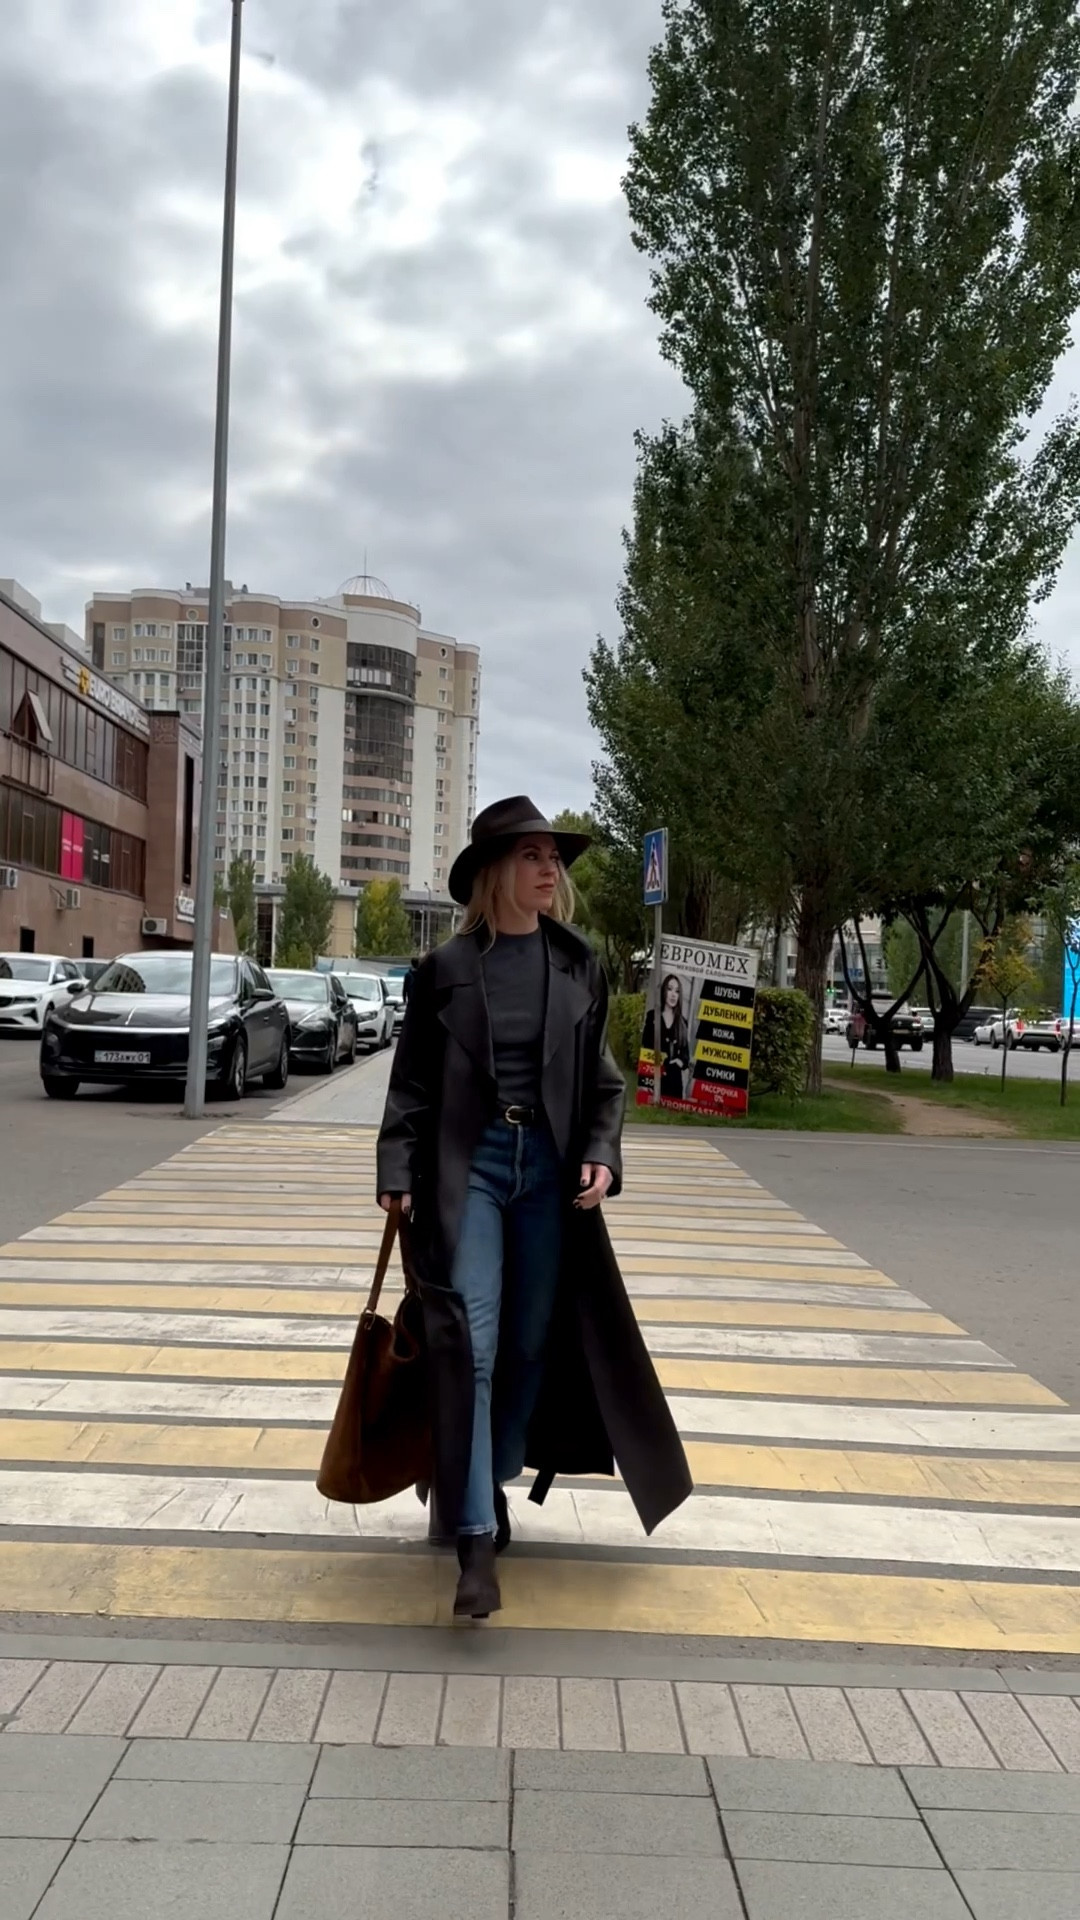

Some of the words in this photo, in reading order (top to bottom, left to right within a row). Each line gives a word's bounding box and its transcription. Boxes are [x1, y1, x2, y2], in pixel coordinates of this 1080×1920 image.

[660, 943, 748, 974] ЕВРОМЕХ
[714, 986, 741, 1000] ШУБЫ
[702, 1004, 747, 1022] ДУБЛЕНКИ
[712, 1027, 735, 1041] КОЖА
[701, 1045, 743, 1063] МУЖСКОЕ
[705, 1066, 735, 1082] СУМКИ
[700, 1083, 739, 1099] РАССРОЧКА
